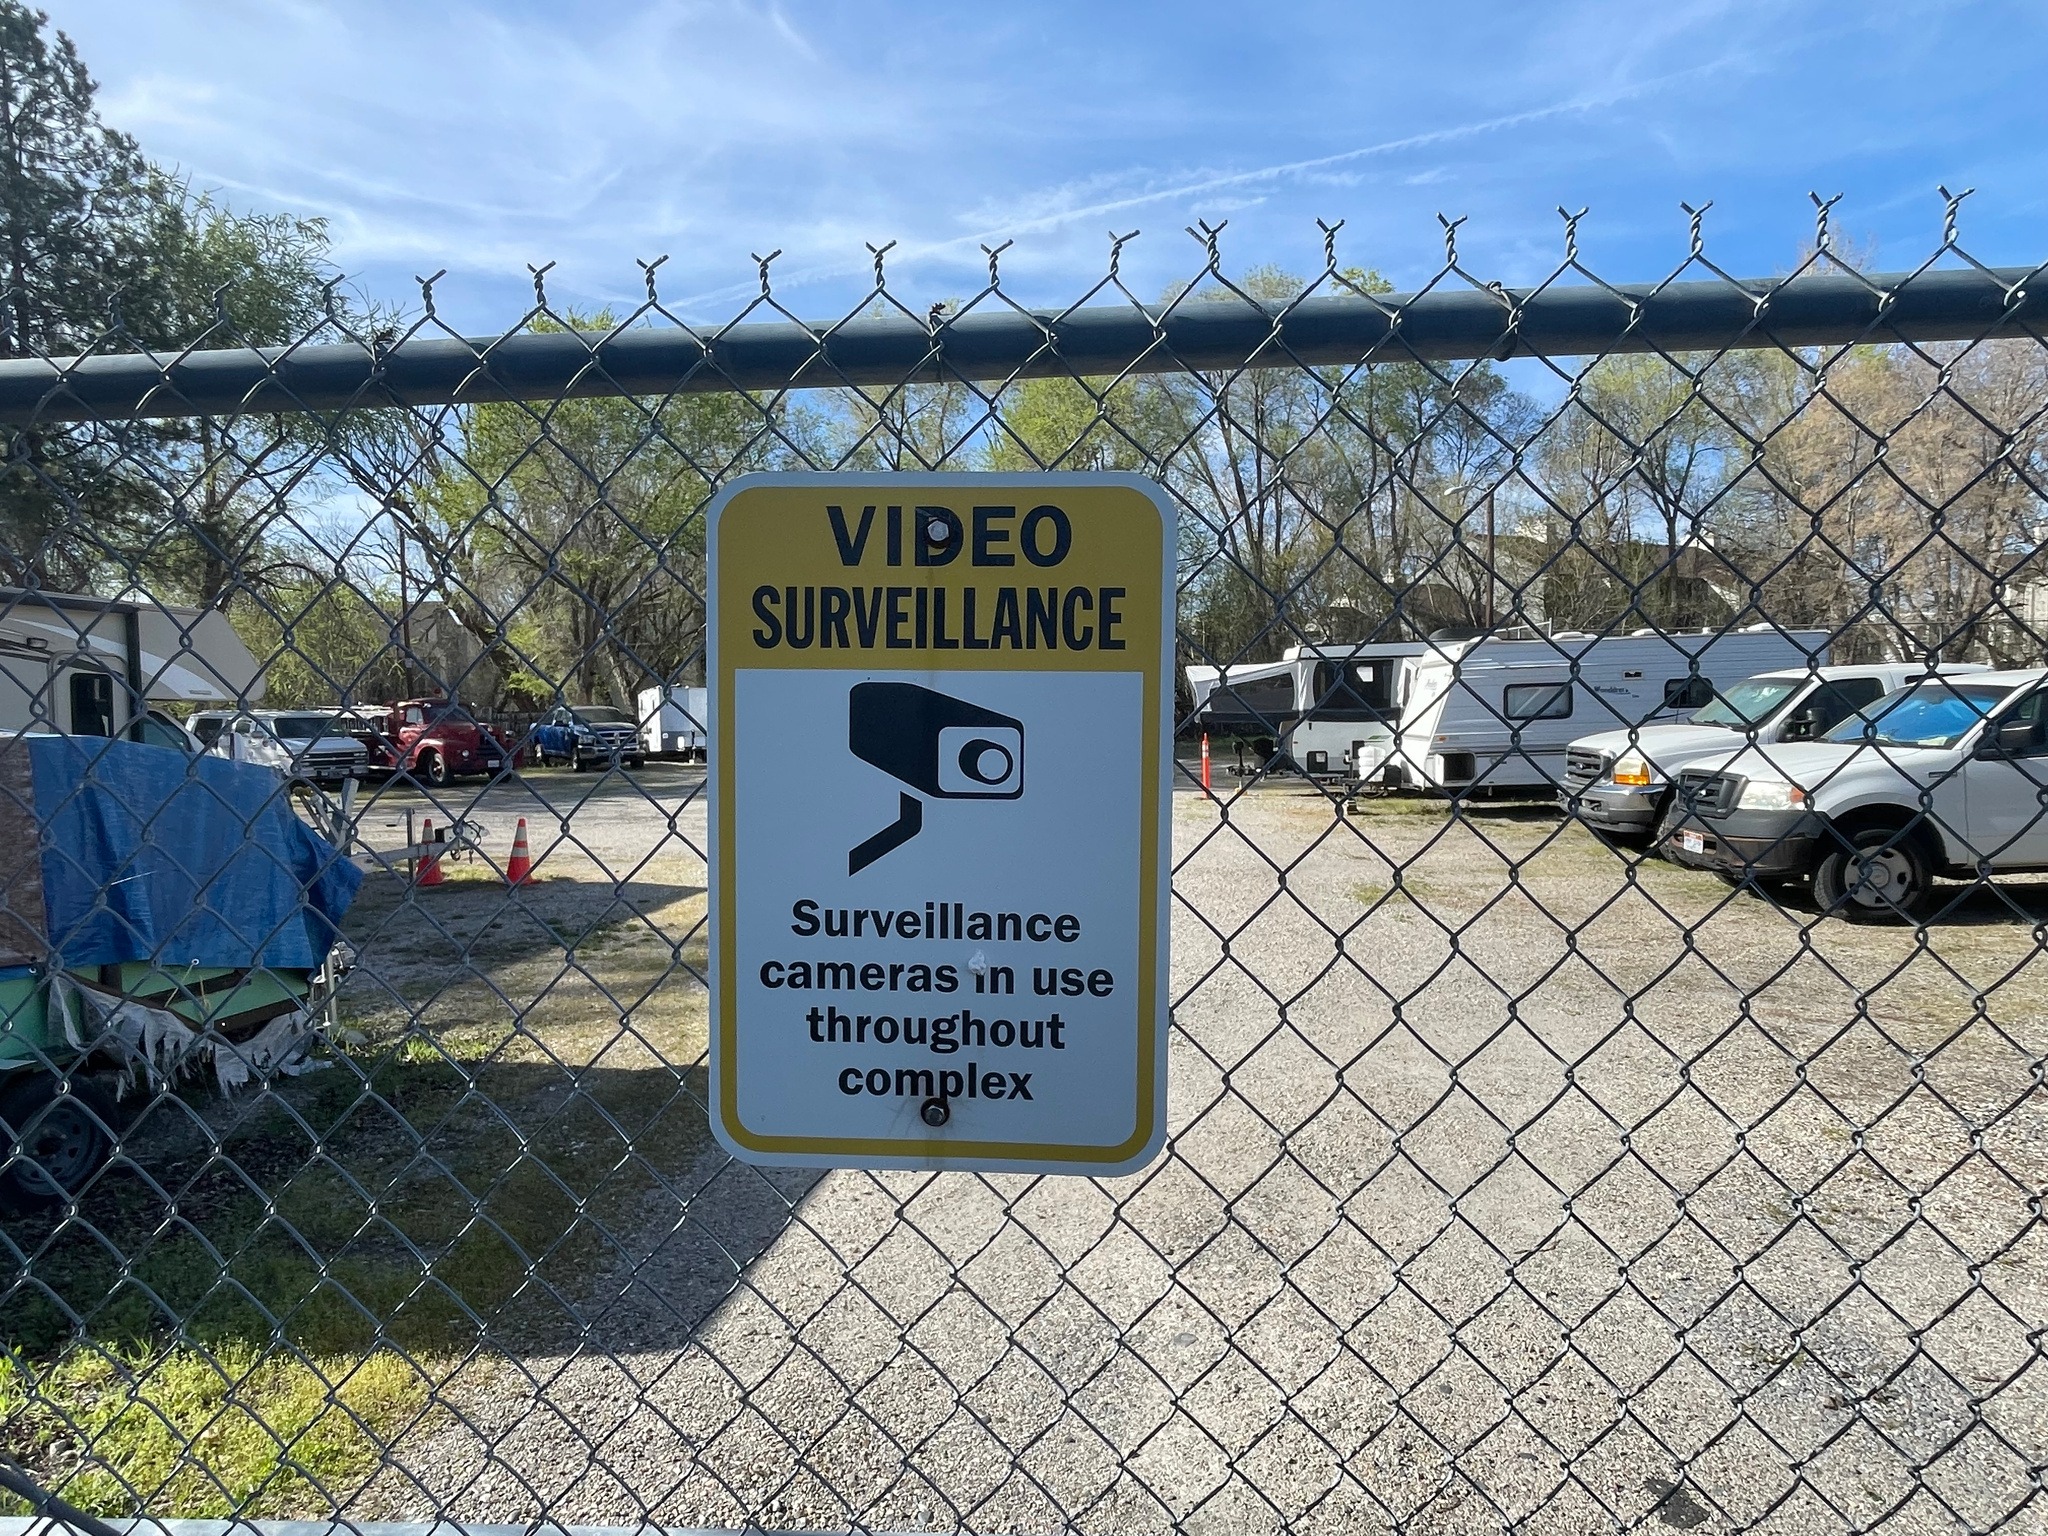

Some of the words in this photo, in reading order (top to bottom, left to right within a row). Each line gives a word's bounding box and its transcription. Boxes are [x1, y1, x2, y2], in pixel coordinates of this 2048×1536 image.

[825, 505, 1072, 568] VIDEO
[752, 585, 1126, 652] SURVEILLANCE
[790, 899, 1081, 943] Surveillance
[759, 960, 959, 993] cameras
[975, 958, 1015, 995] in
[1033, 967, 1114, 998] use
[805, 1005, 1066, 1054] throughout
[838, 1062, 1034, 1104] complex
